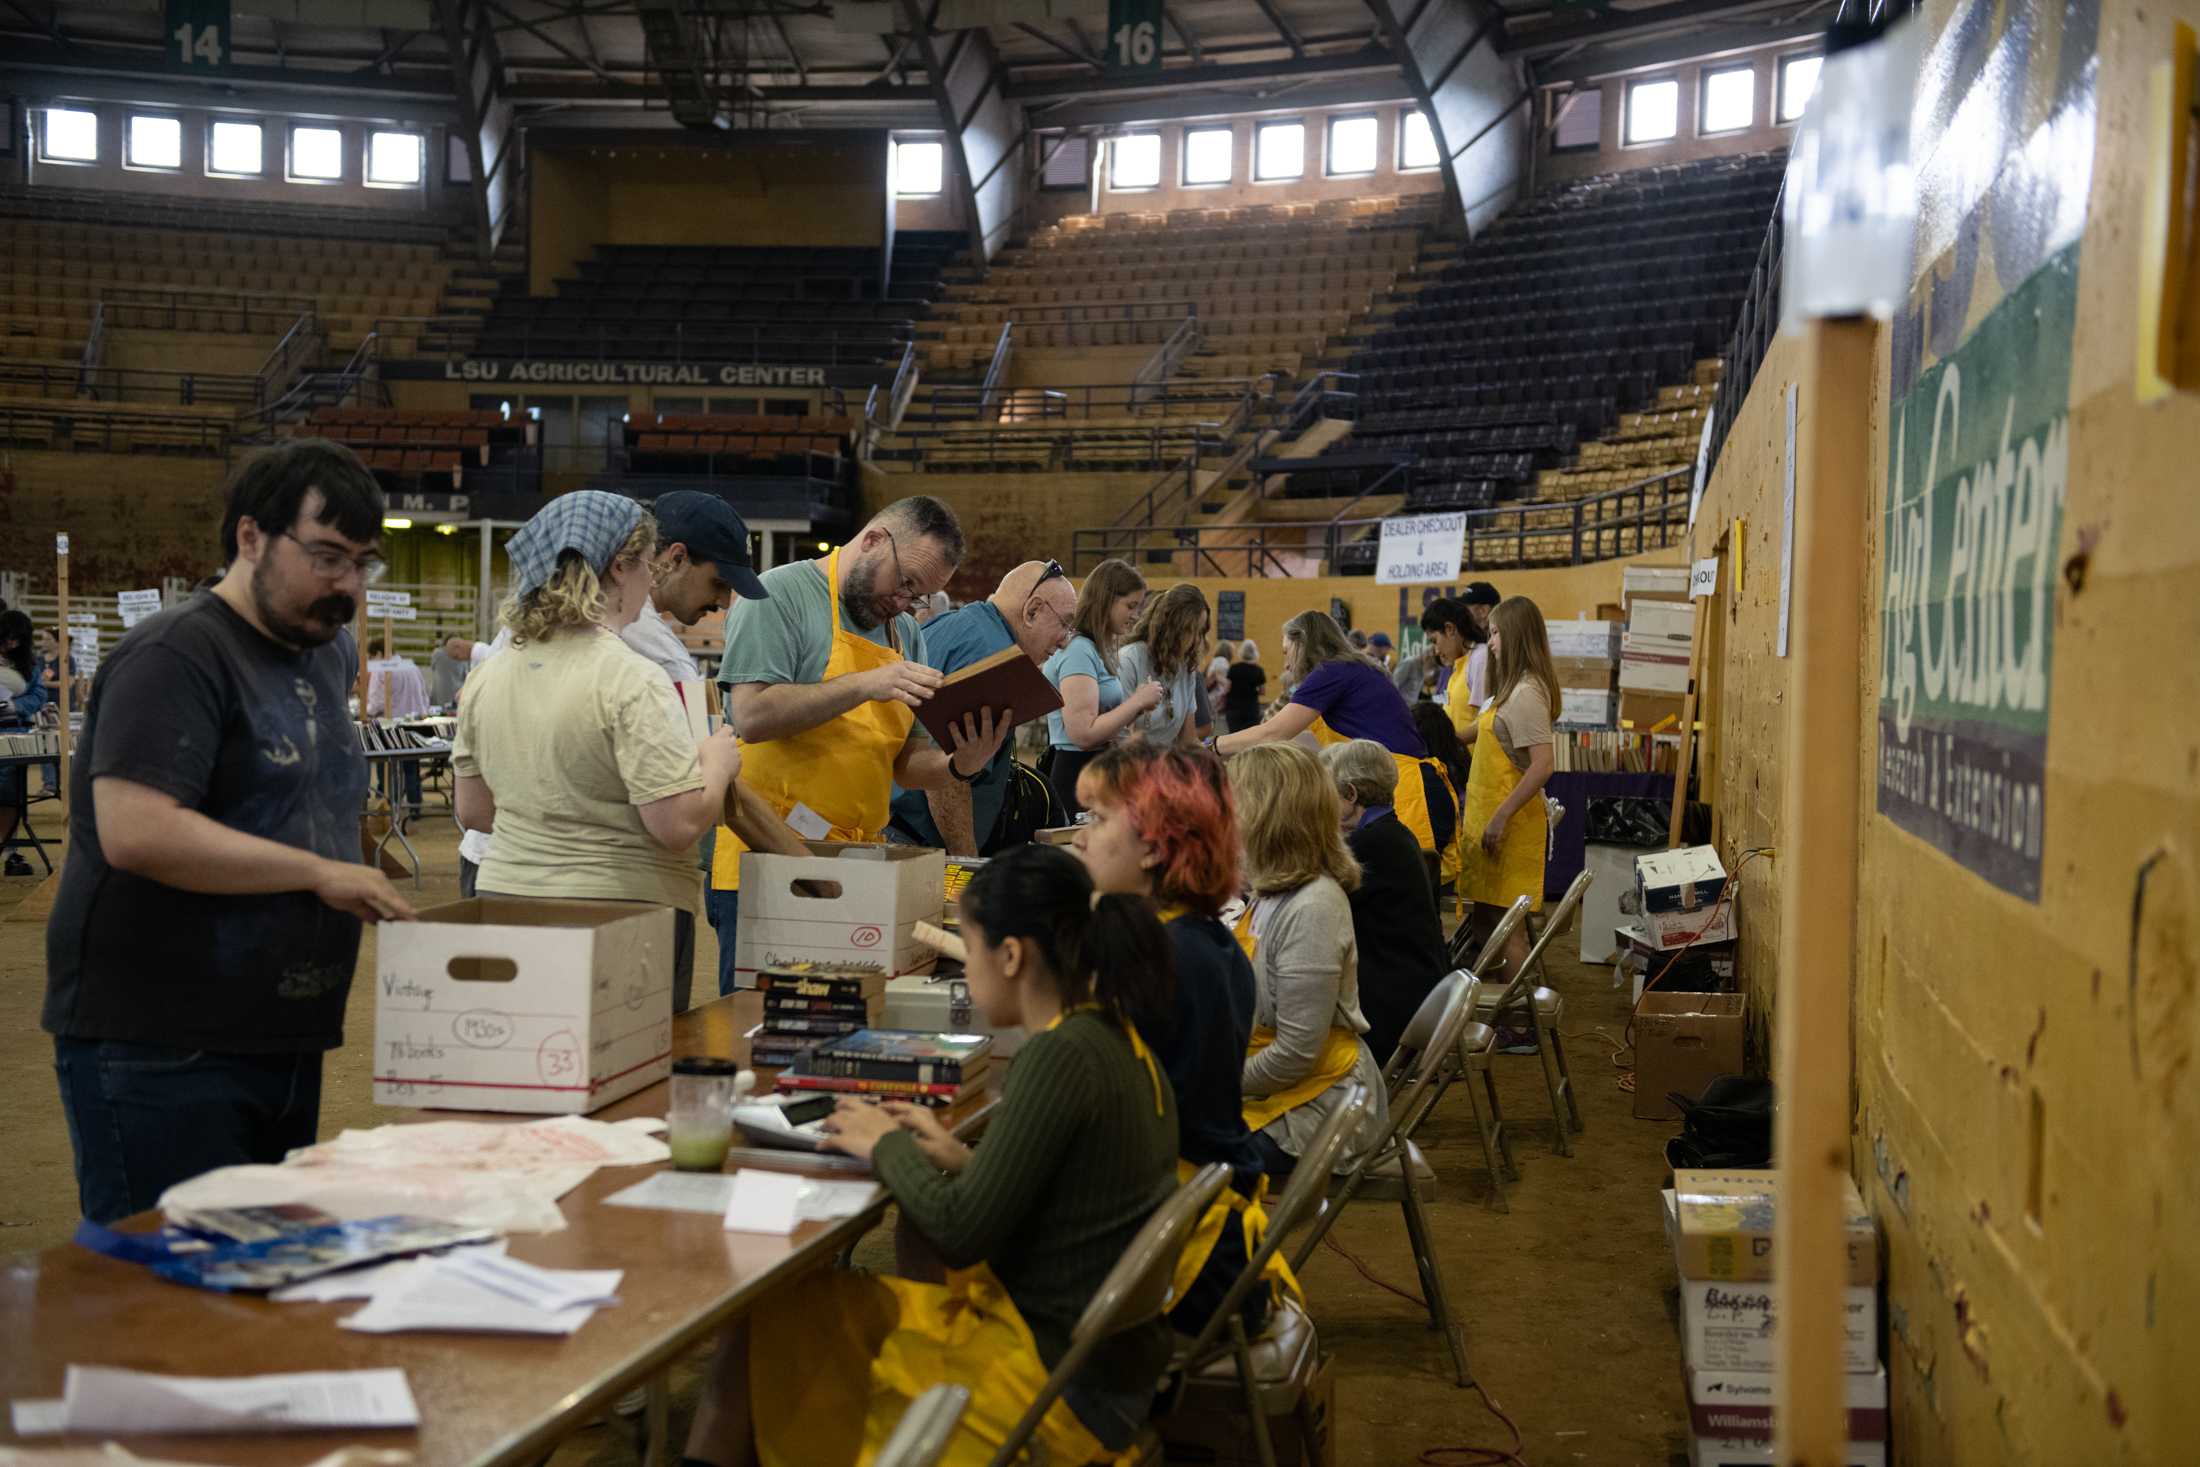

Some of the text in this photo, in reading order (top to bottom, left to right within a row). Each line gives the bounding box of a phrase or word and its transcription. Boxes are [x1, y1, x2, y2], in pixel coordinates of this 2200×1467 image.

[174, 22, 222, 65] 14
[1114, 21, 1155, 66] 16
[444, 361, 826, 385] LSU AGRICULTURAL CENTER
[1384, 516, 1463, 537] DEALER CHECKOUT
[1388, 561, 1449, 578] HOLDING AREA
[548, 1050, 574, 1076] 33
[1707, 1413, 1775, 1428] Williams
